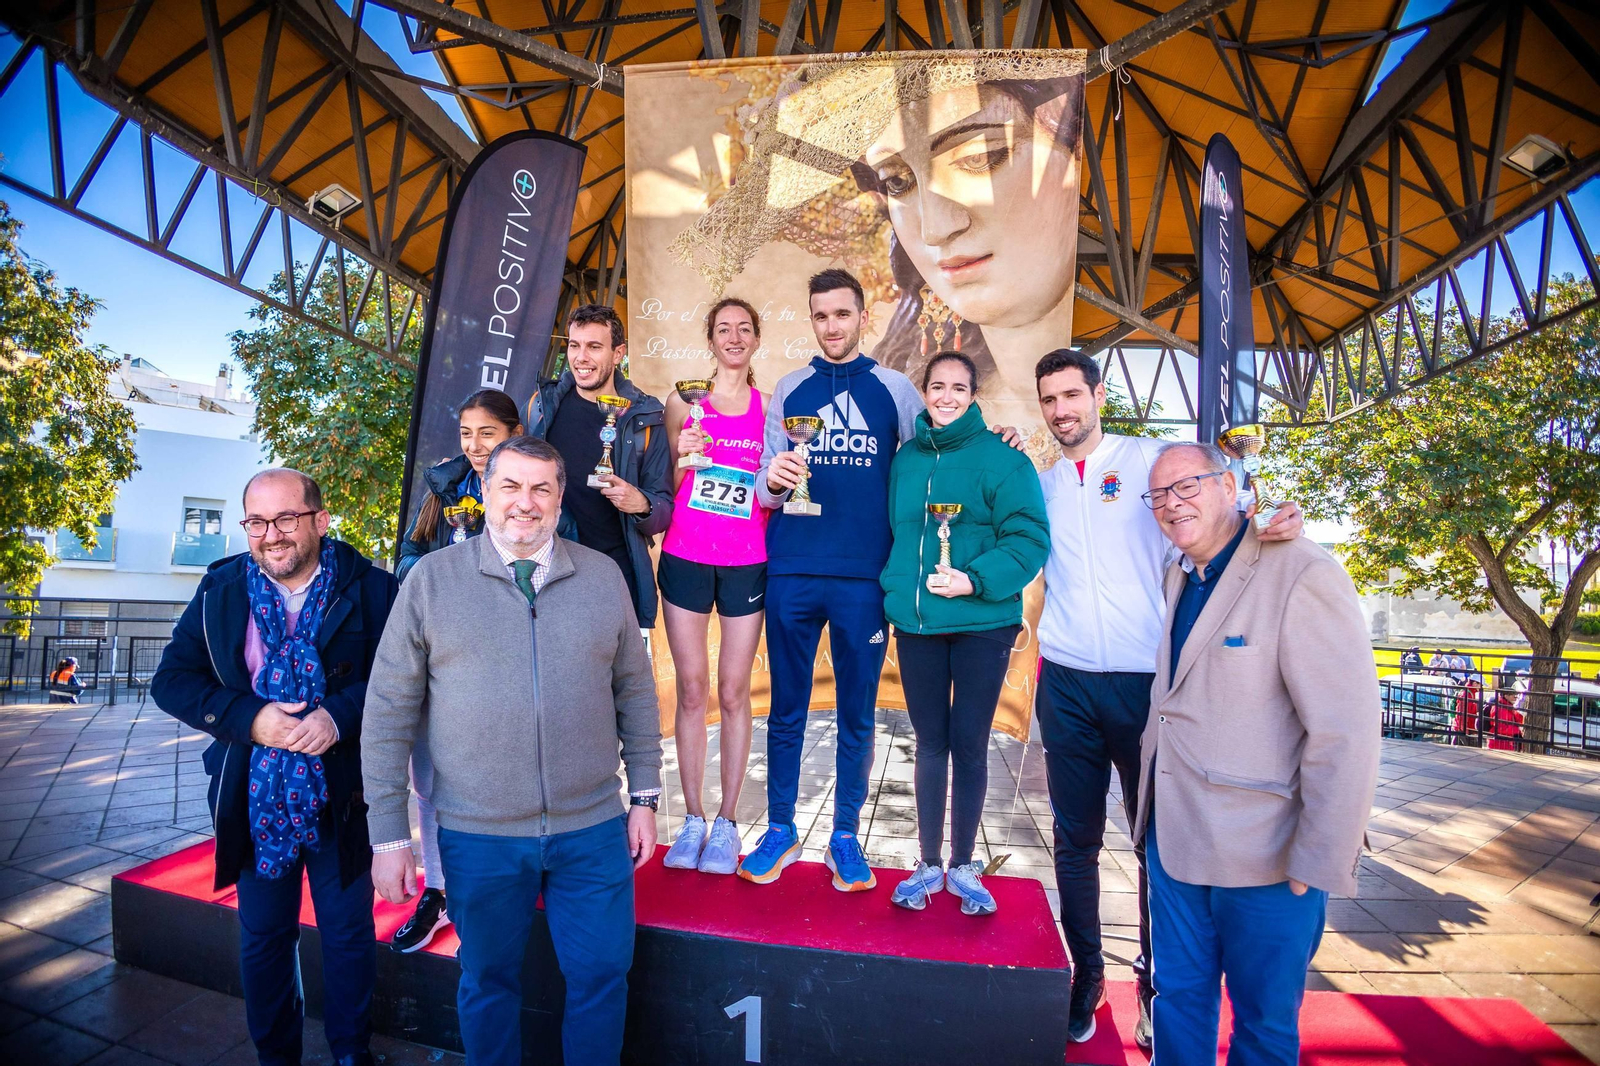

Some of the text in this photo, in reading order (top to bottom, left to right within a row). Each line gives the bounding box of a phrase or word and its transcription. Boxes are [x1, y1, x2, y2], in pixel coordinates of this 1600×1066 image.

[636, 297, 675, 321] Por
[481, 348, 512, 393] EL
[807, 428, 878, 455] didas
[807, 456, 872, 467] THLETICS
[700, 480, 747, 505] 273
[724, 995, 762, 1064] 1
